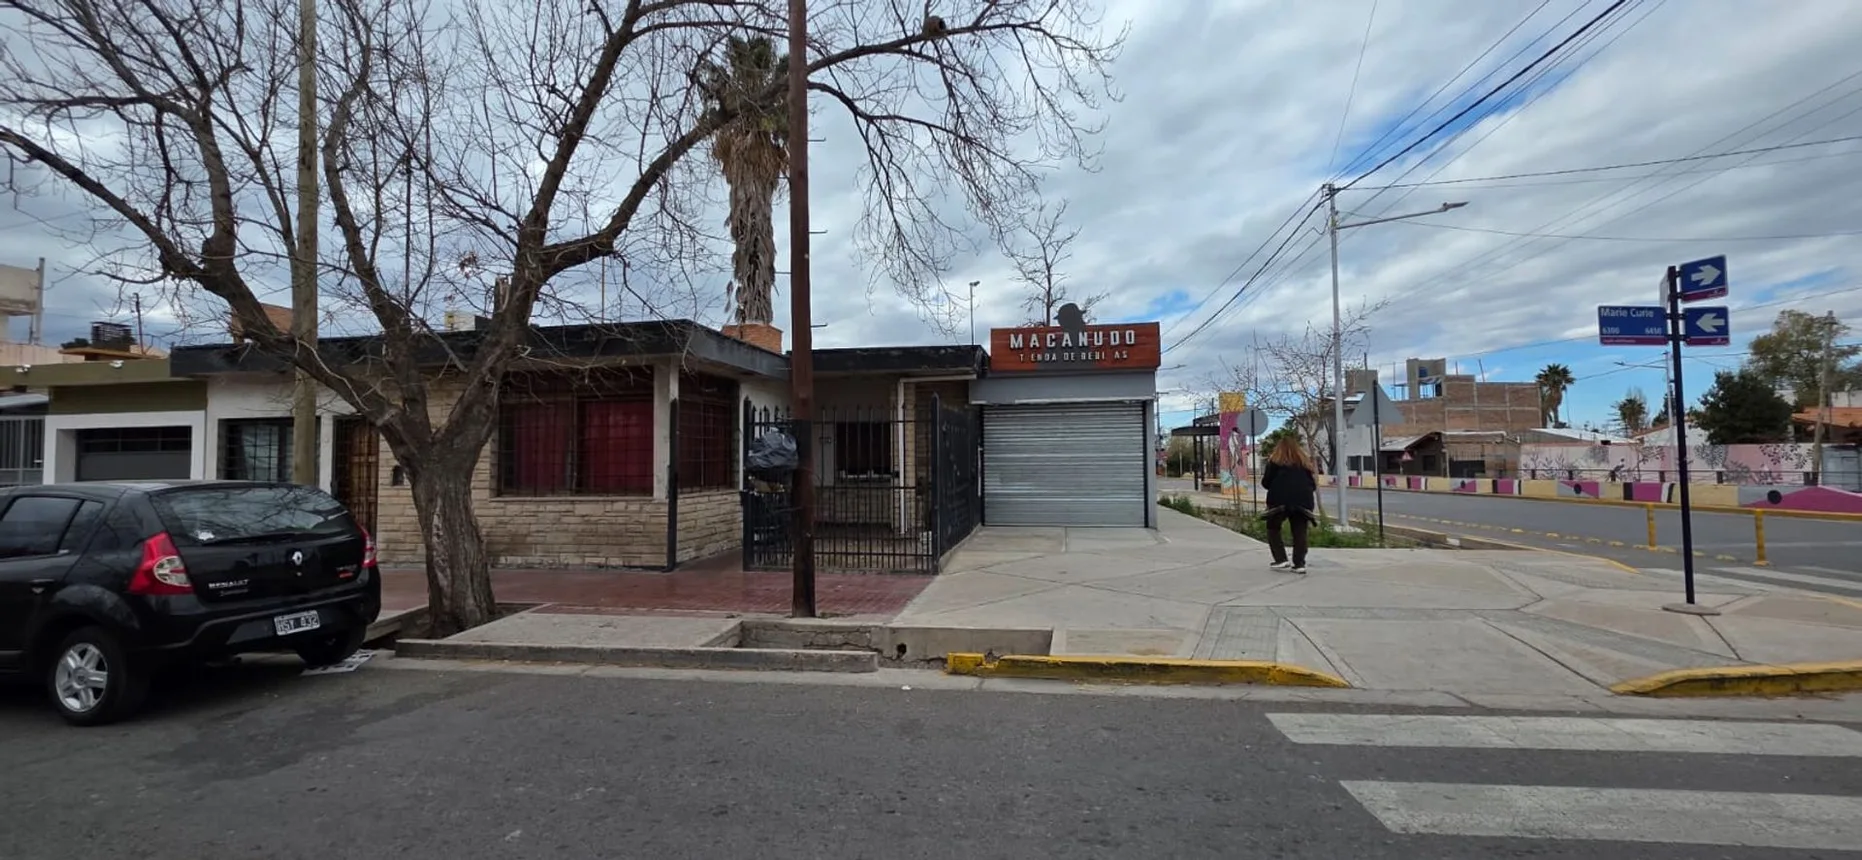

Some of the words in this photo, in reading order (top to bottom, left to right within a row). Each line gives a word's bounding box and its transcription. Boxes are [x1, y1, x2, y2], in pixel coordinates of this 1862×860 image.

[1600, 307, 1628, 318] Marie
[1630, 308, 1654, 318] Curie
[1009, 330, 1135, 349] MACANUDO
[1019, 351, 1057, 362] TENDA
[1063, 352, 1075, 361] DE
[1080, 350, 1128, 361] BEBIAS
